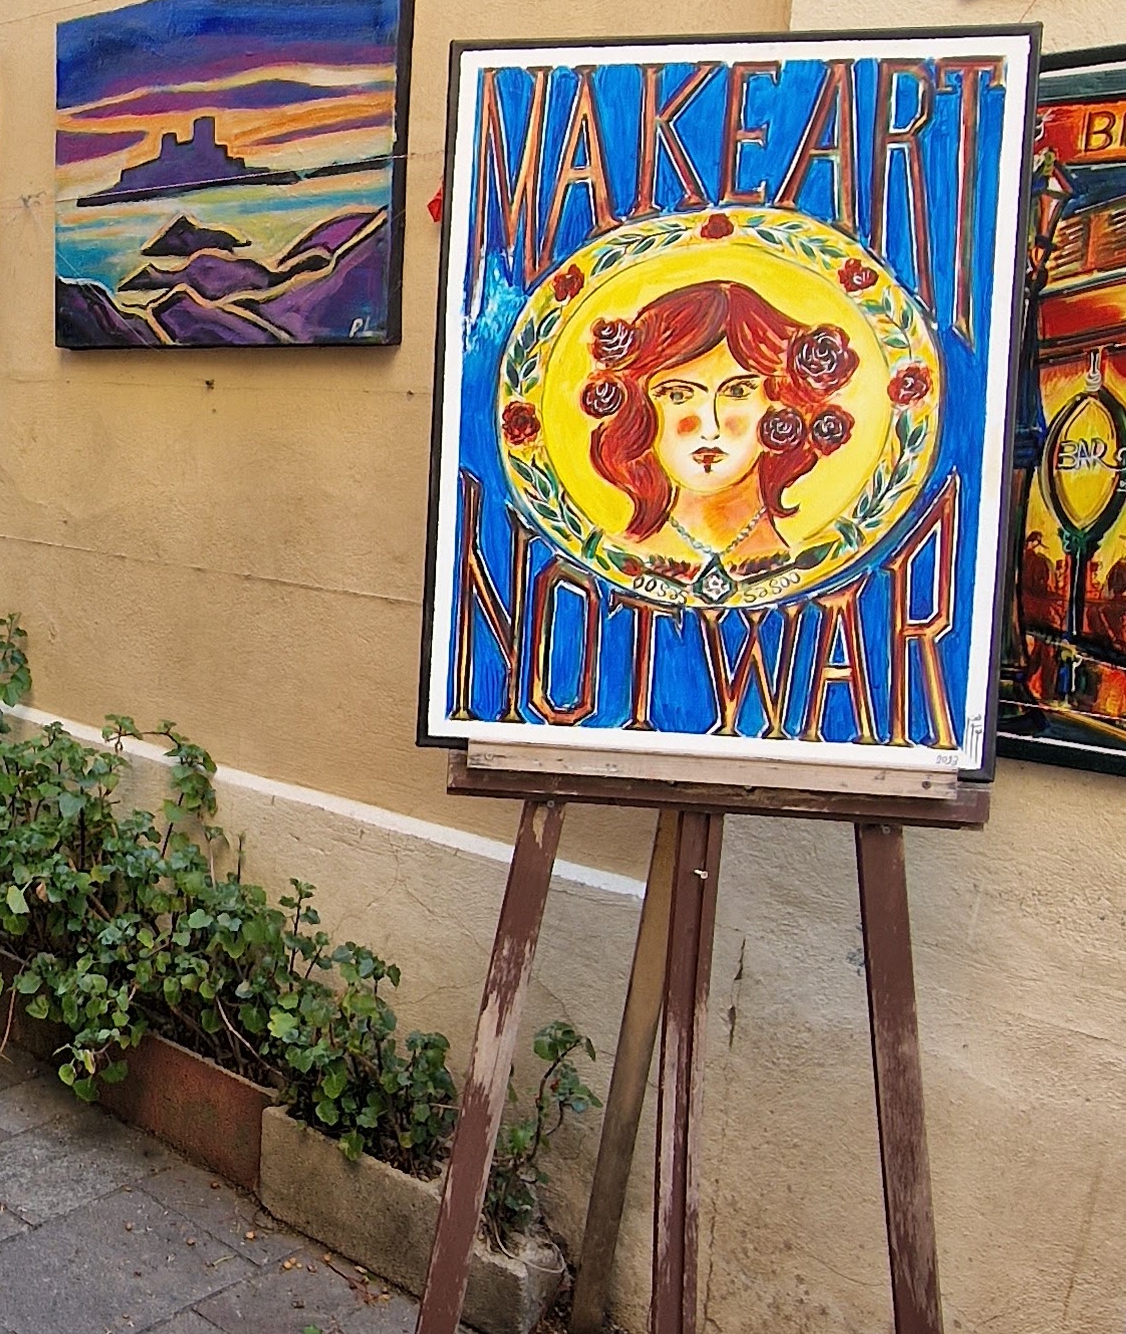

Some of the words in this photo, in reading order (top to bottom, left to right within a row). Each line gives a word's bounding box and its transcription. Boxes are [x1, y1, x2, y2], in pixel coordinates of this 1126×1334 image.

[467, 61, 782, 311] MAKE
[776, 57, 1007, 350] ART
[1056, 437, 1120, 471] BAR
[448, 467, 686, 731] NOT
[696, 470, 960, 750] WAR
